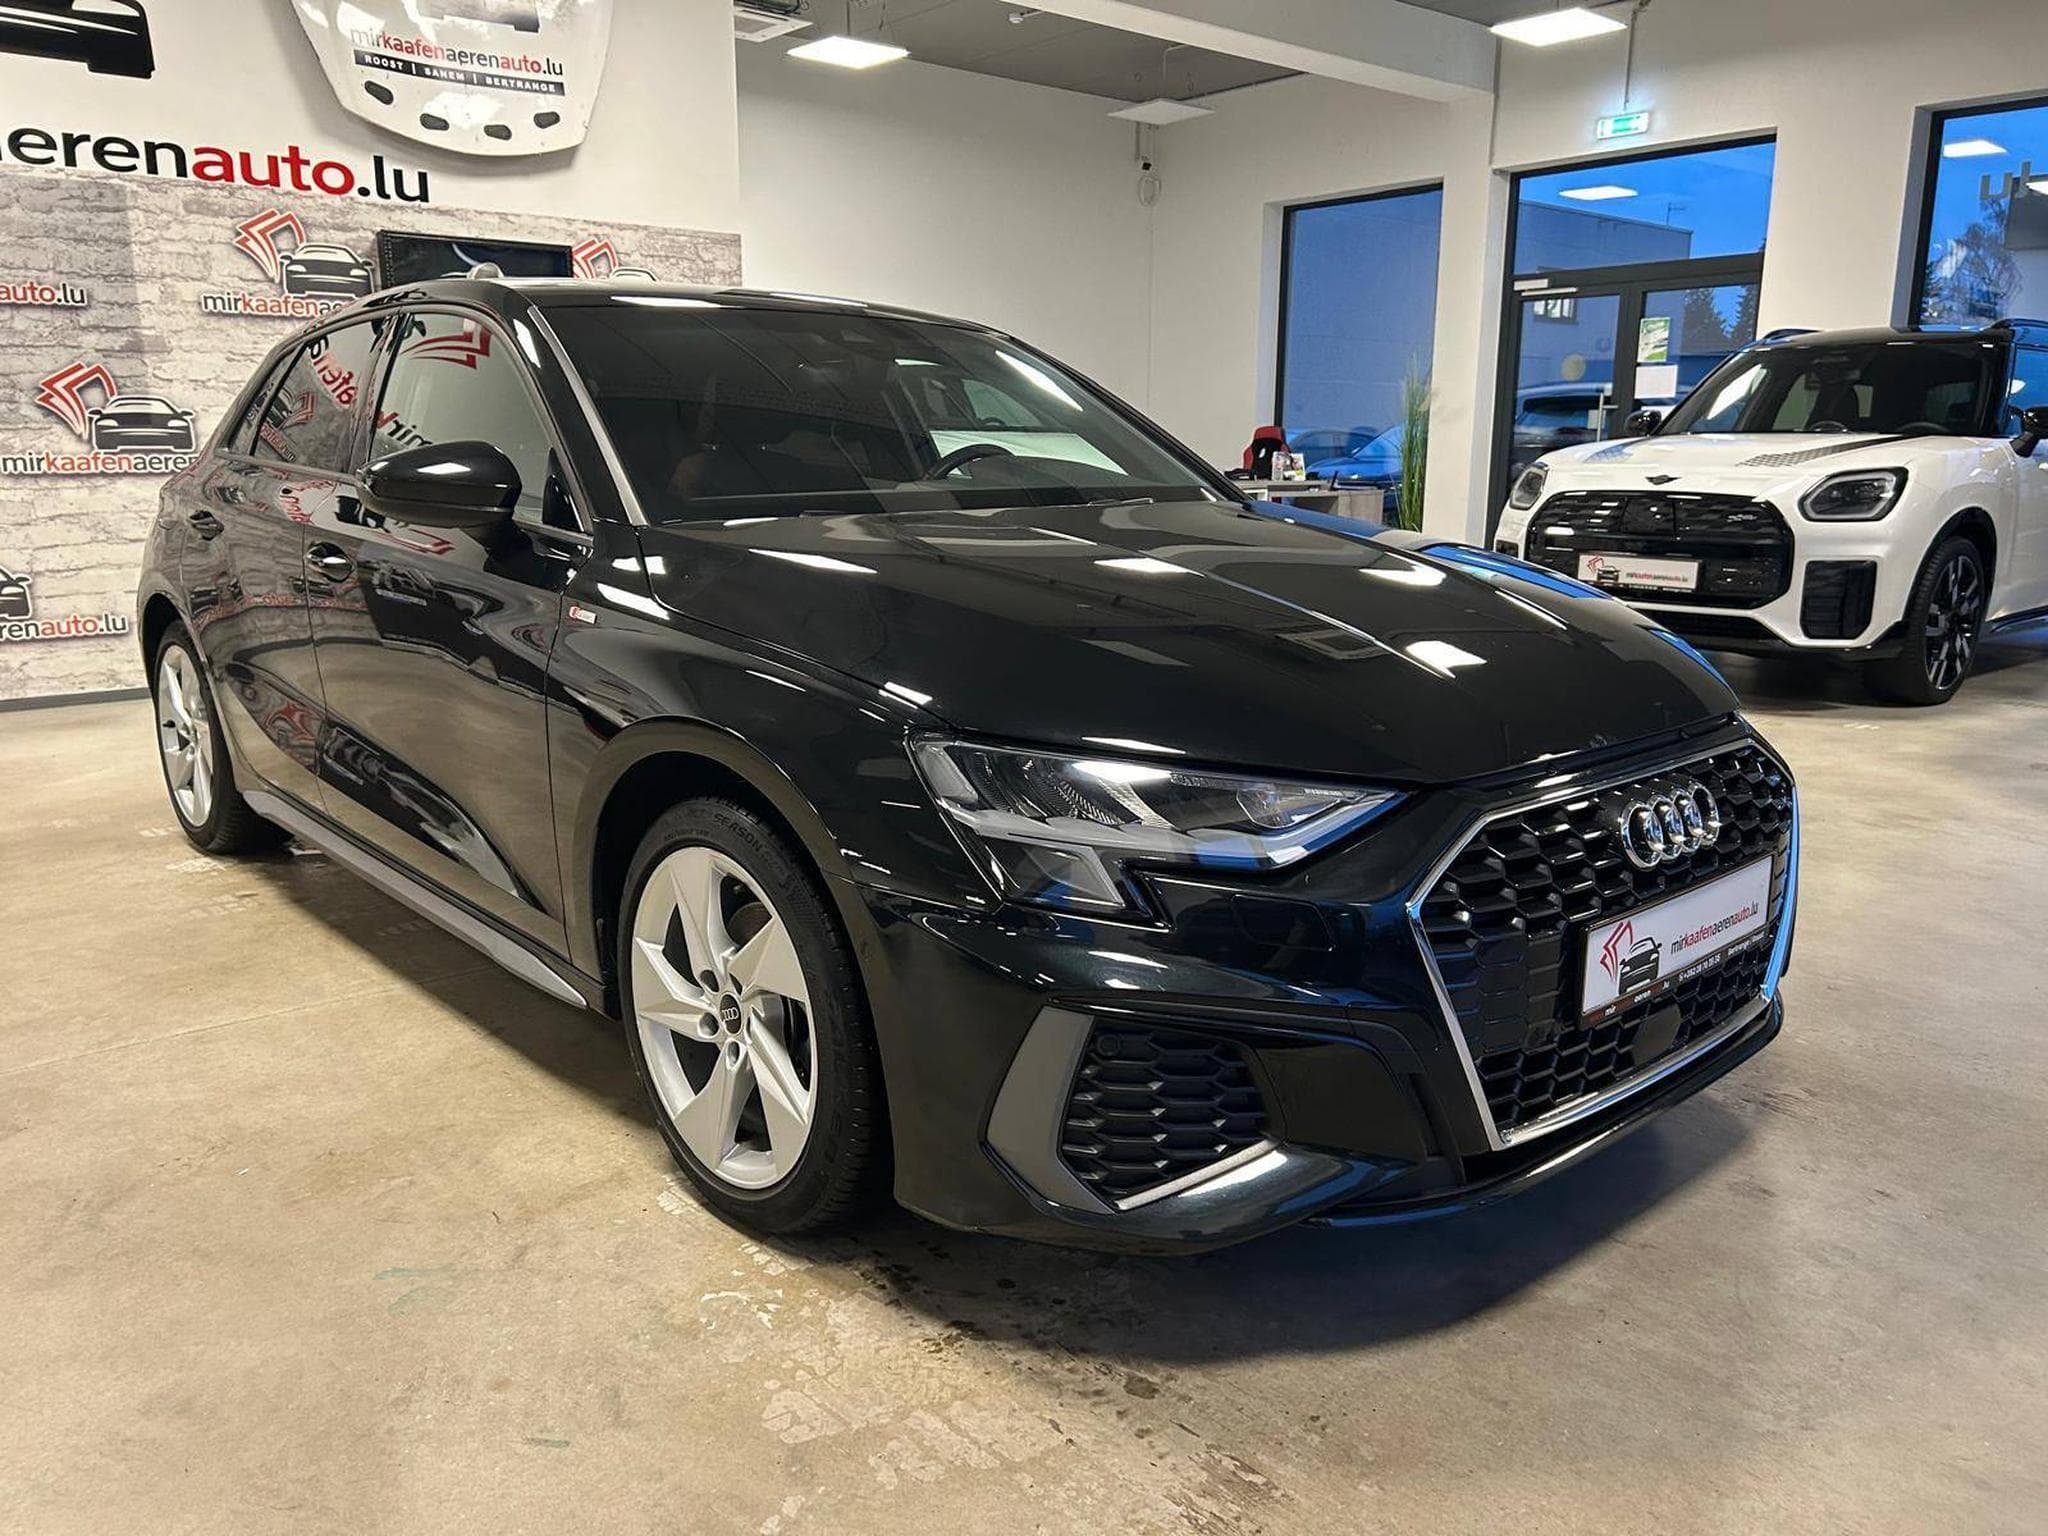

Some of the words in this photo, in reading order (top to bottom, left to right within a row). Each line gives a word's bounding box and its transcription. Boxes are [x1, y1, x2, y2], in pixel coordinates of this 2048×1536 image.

[351, 27, 563, 76] mirkaafenaerenauto.lu
[365, 54, 403, 71] ROOST
[0, 128, 430, 203] erenauto.lu
[1671, 901, 1759, 955] mirkaafenaerenauto.lu
